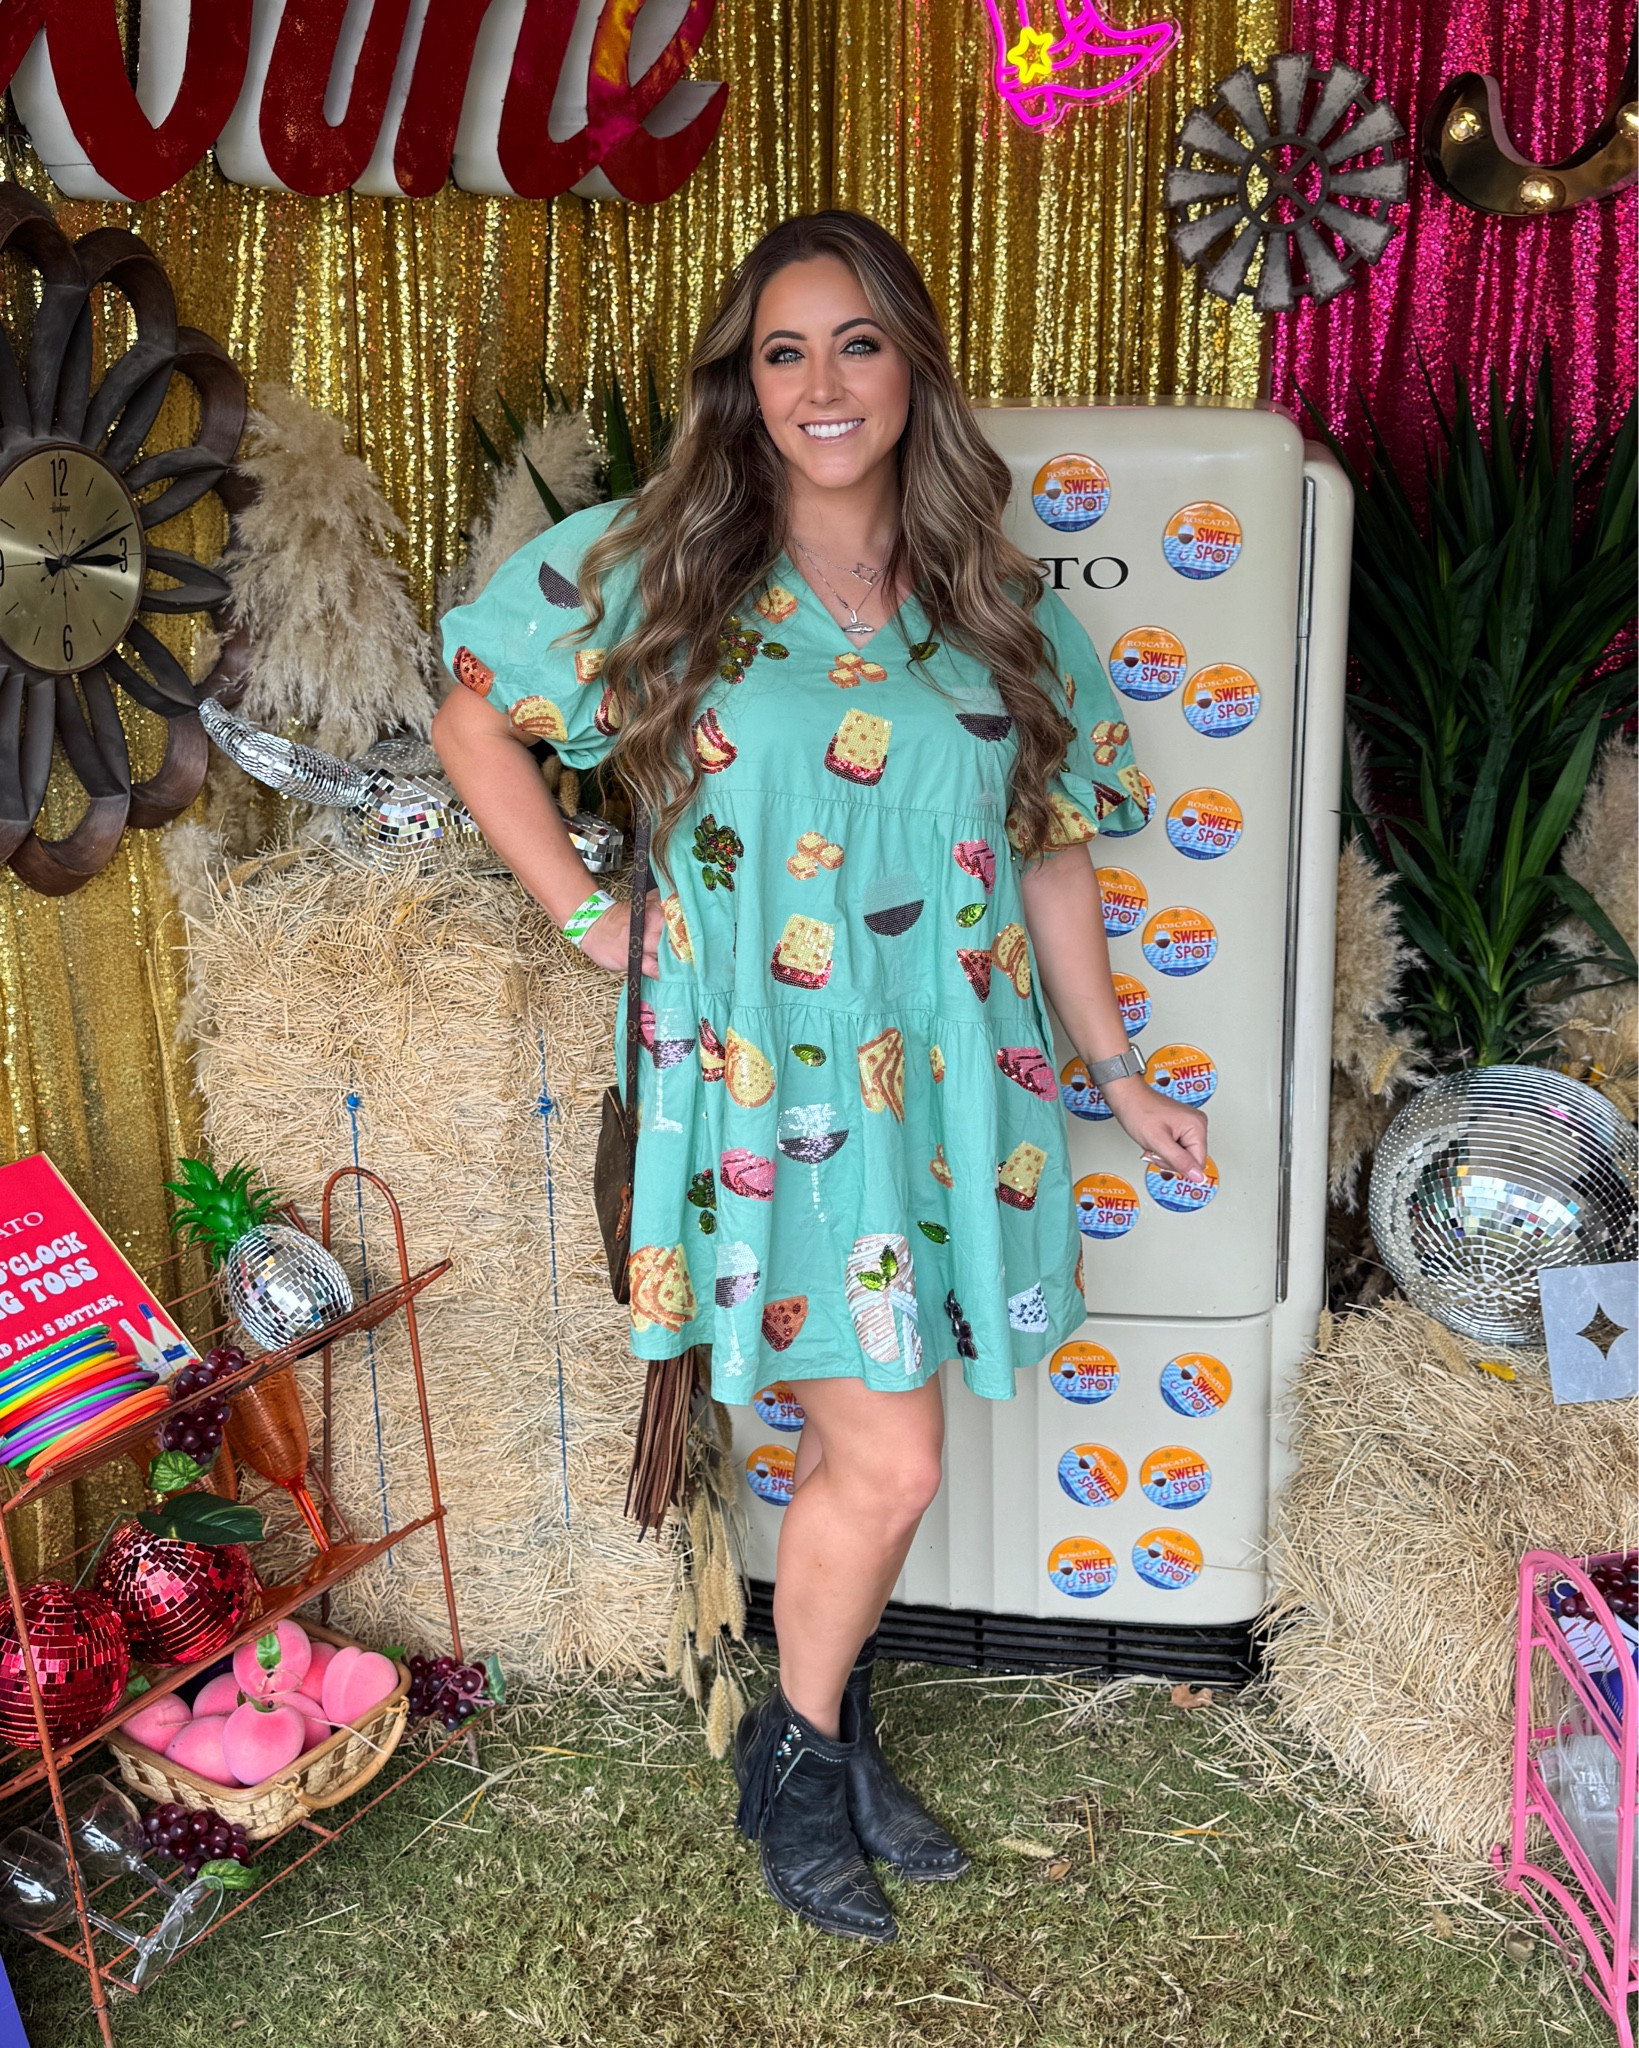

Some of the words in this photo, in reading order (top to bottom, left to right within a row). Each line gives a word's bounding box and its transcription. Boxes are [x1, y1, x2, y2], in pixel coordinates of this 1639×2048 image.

[50, 458, 69, 498] 12
[1064, 478, 1106, 494] SWEET
[1066, 495, 1104, 511] SPOT
[1183, 515, 1230, 527] ROSCATO
[1196, 527, 1240, 548] SWEET
[1194, 544, 1234, 564] SPOT
[1039, 556, 1129, 590] TO
[62, 624, 74, 662] 6
[1127, 640, 1174, 649] ROSCATO
[1142, 650, 1184, 669] SWEET
[1141, 667, 1180, 685] SPOT
[1196, 675, 1244, 689] ROSCATO
[1214, 684, 1256, 702] SWEET
[1218, 701, 1255, 718] SPOT
[1187, 800, 1233, 813] ROSCATO
[1199, 812, 1242, 834] SWEET
[1196, 828, 1234, 848] SPOT
[1098, 880, 1137, 892] OSCATO
[1104, 890, 1146, 911] SWEET
[1103, 906, 1140, 925] SPOT
[1155, 919, 1202, 930] ROSCATO
[1172, 929, 1213, 944] SWEET
[1175, 944, 1212, 959] SPOT
[1154, 1055, 1198, 1069] ROSCATO
[1172, 1063, 1211, 1080] SWEET
[1176, 1078, 1212, 1095] SPOT
[1082, 1187, 1127, 1195] ROSCATO
[1174, 1182, 1211, 1202] SPOT
[1096, 1195, 1136, 1212] SWEET
[1097, 1210, 1133, 1226] SPOT
[20, 1257, 99, 1303] TOSS
[14, 1329, 45, 1351] ALL
[54, 1293, 124, 1332] BOTTLES,
[1077, 1363, 1116, 1377] SWEET
[1080, 1377, 1114, 1390] SPOT
[1192, 1376, 1224, 1408] SWEET
[1181, 1386, 1211, 1415] SPOT
[780, 1404, 806, 1419] SPO
[1167, 1463, 1205, 1481] SWEET
[771, 1479, 796, 1495] SPO
[1077, 1475, 1105, 1505] SPOT
[1089, 1467, 1119, 1500] SWEET
[1172, 1477, 1206, 1494] SPOT
[1074, 1557, 1112, 1572] SWEET
[1162, 1549, 1201, 1574] SWEET
[1078, 1571, 1111, 1584] SPOT
[1157, 1562, 1191, 1585] SPOT
